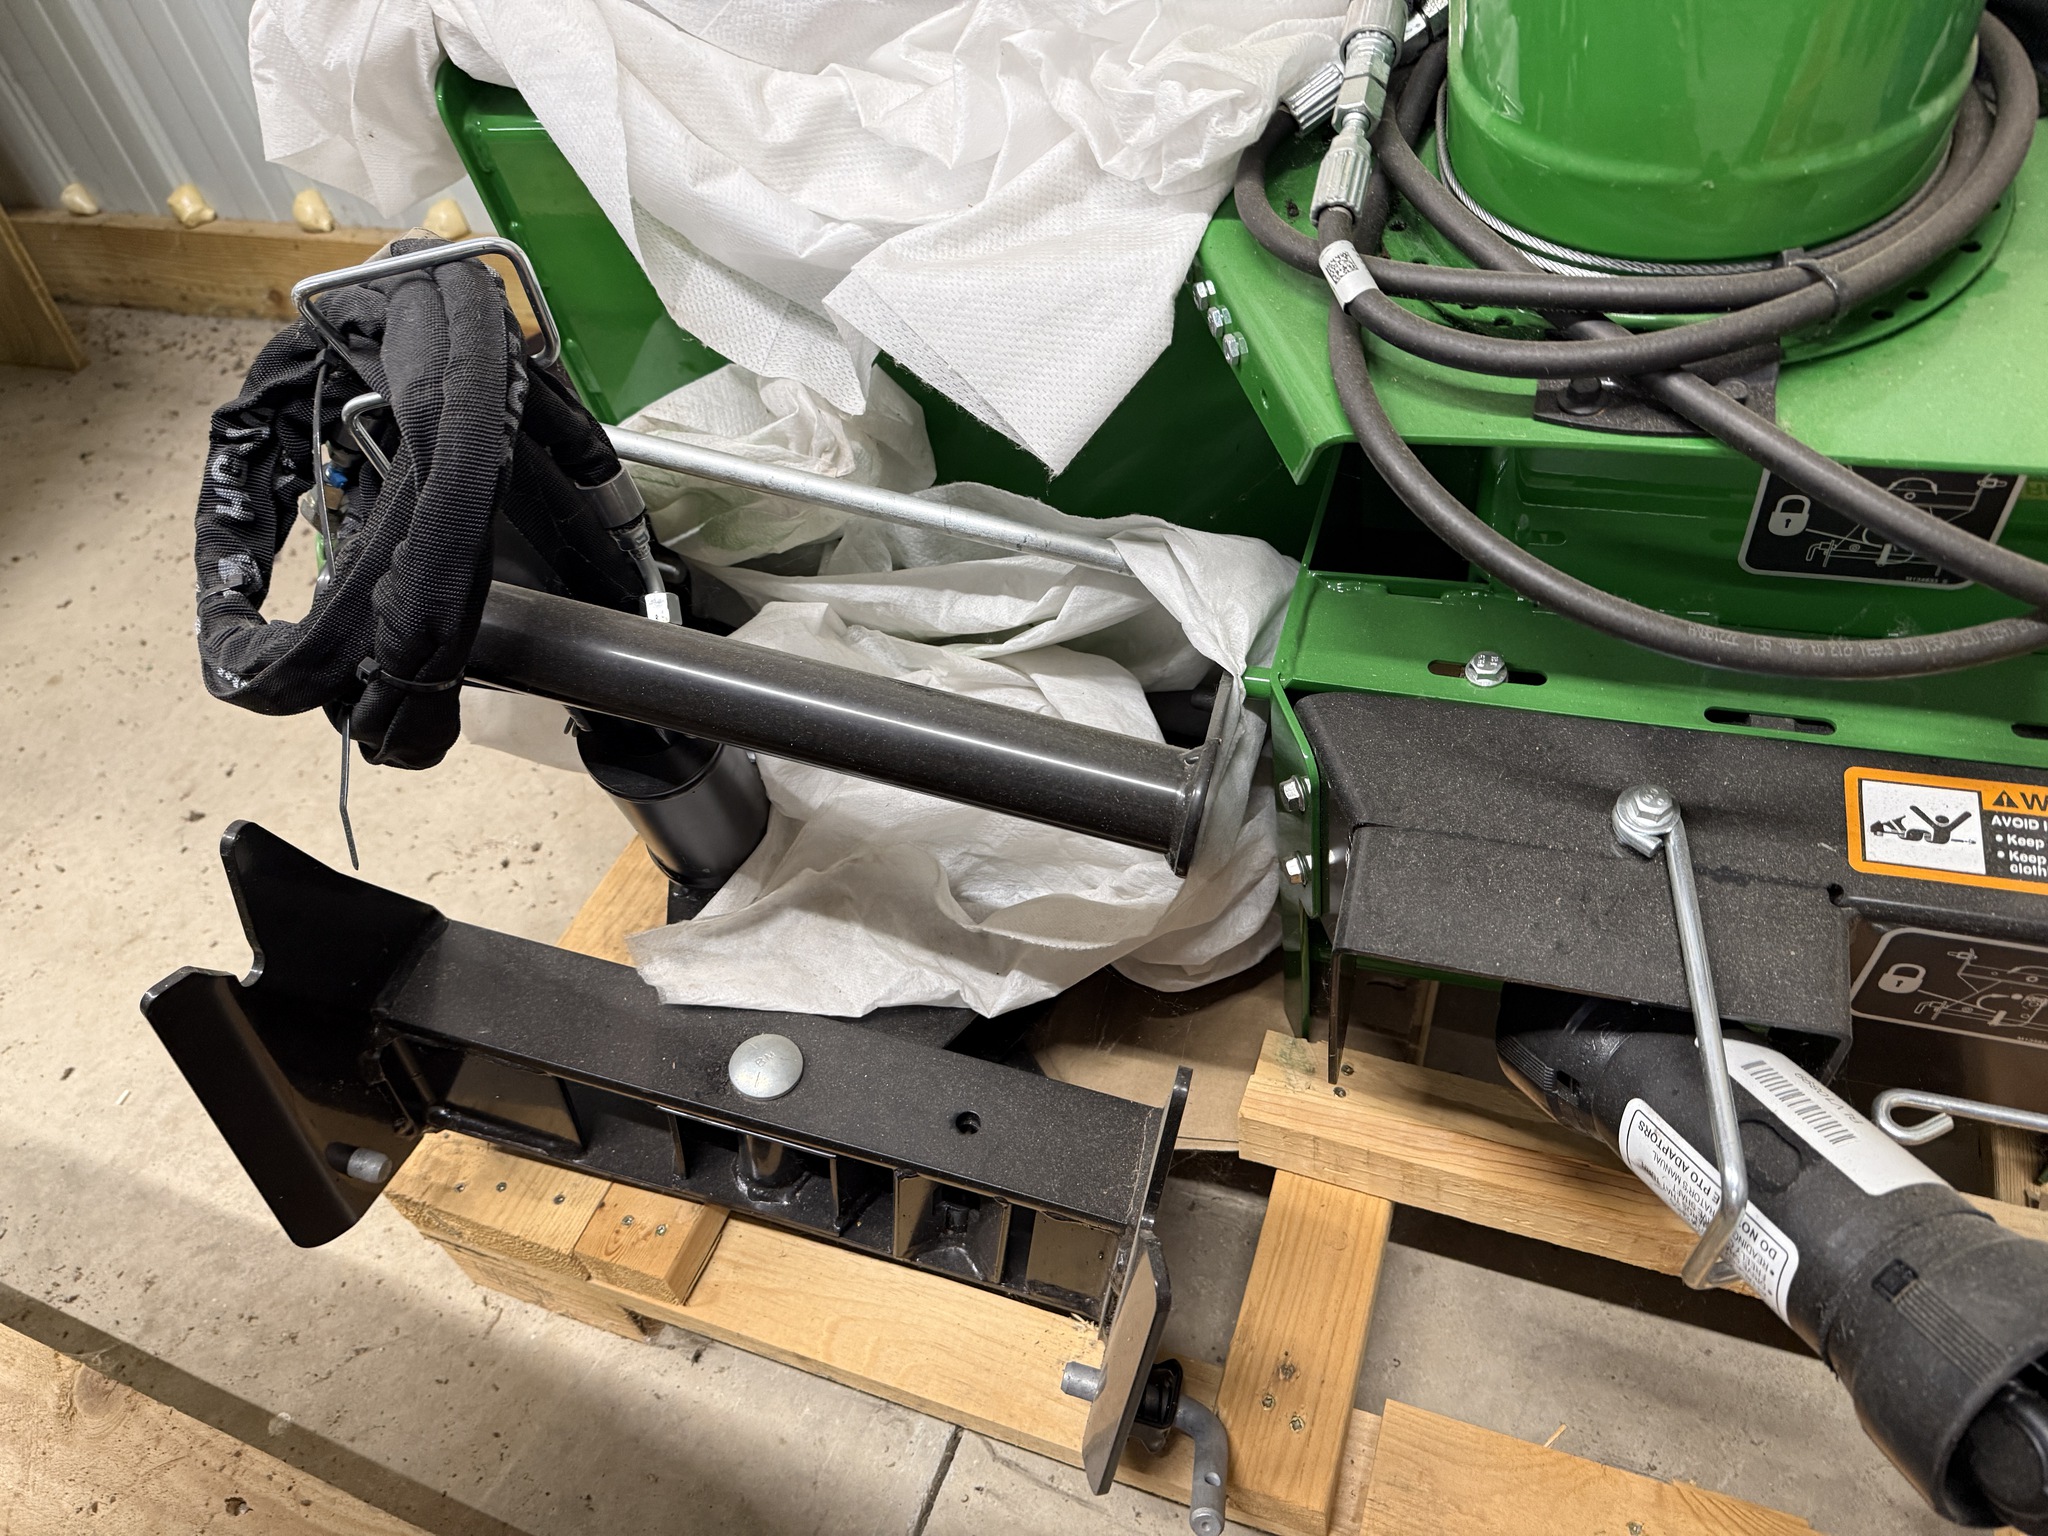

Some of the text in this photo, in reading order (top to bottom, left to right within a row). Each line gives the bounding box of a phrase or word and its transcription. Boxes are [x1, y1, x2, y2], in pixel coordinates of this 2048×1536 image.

[1991, 814, 2040, 831] AVOID
[2006, 833, 2045, 851] Keep
[2008, 849, 2047, 866] Keep
[1637, 1119, 1689, 1172] ADAPTORS
[1652, 1150, 1682, 1184] MANUAL
[1689, 1170, 1712, 1196] PTO
[1738, 1219, 1760, 1242] NO
[1757, 1239, 1778, 1260] DO
